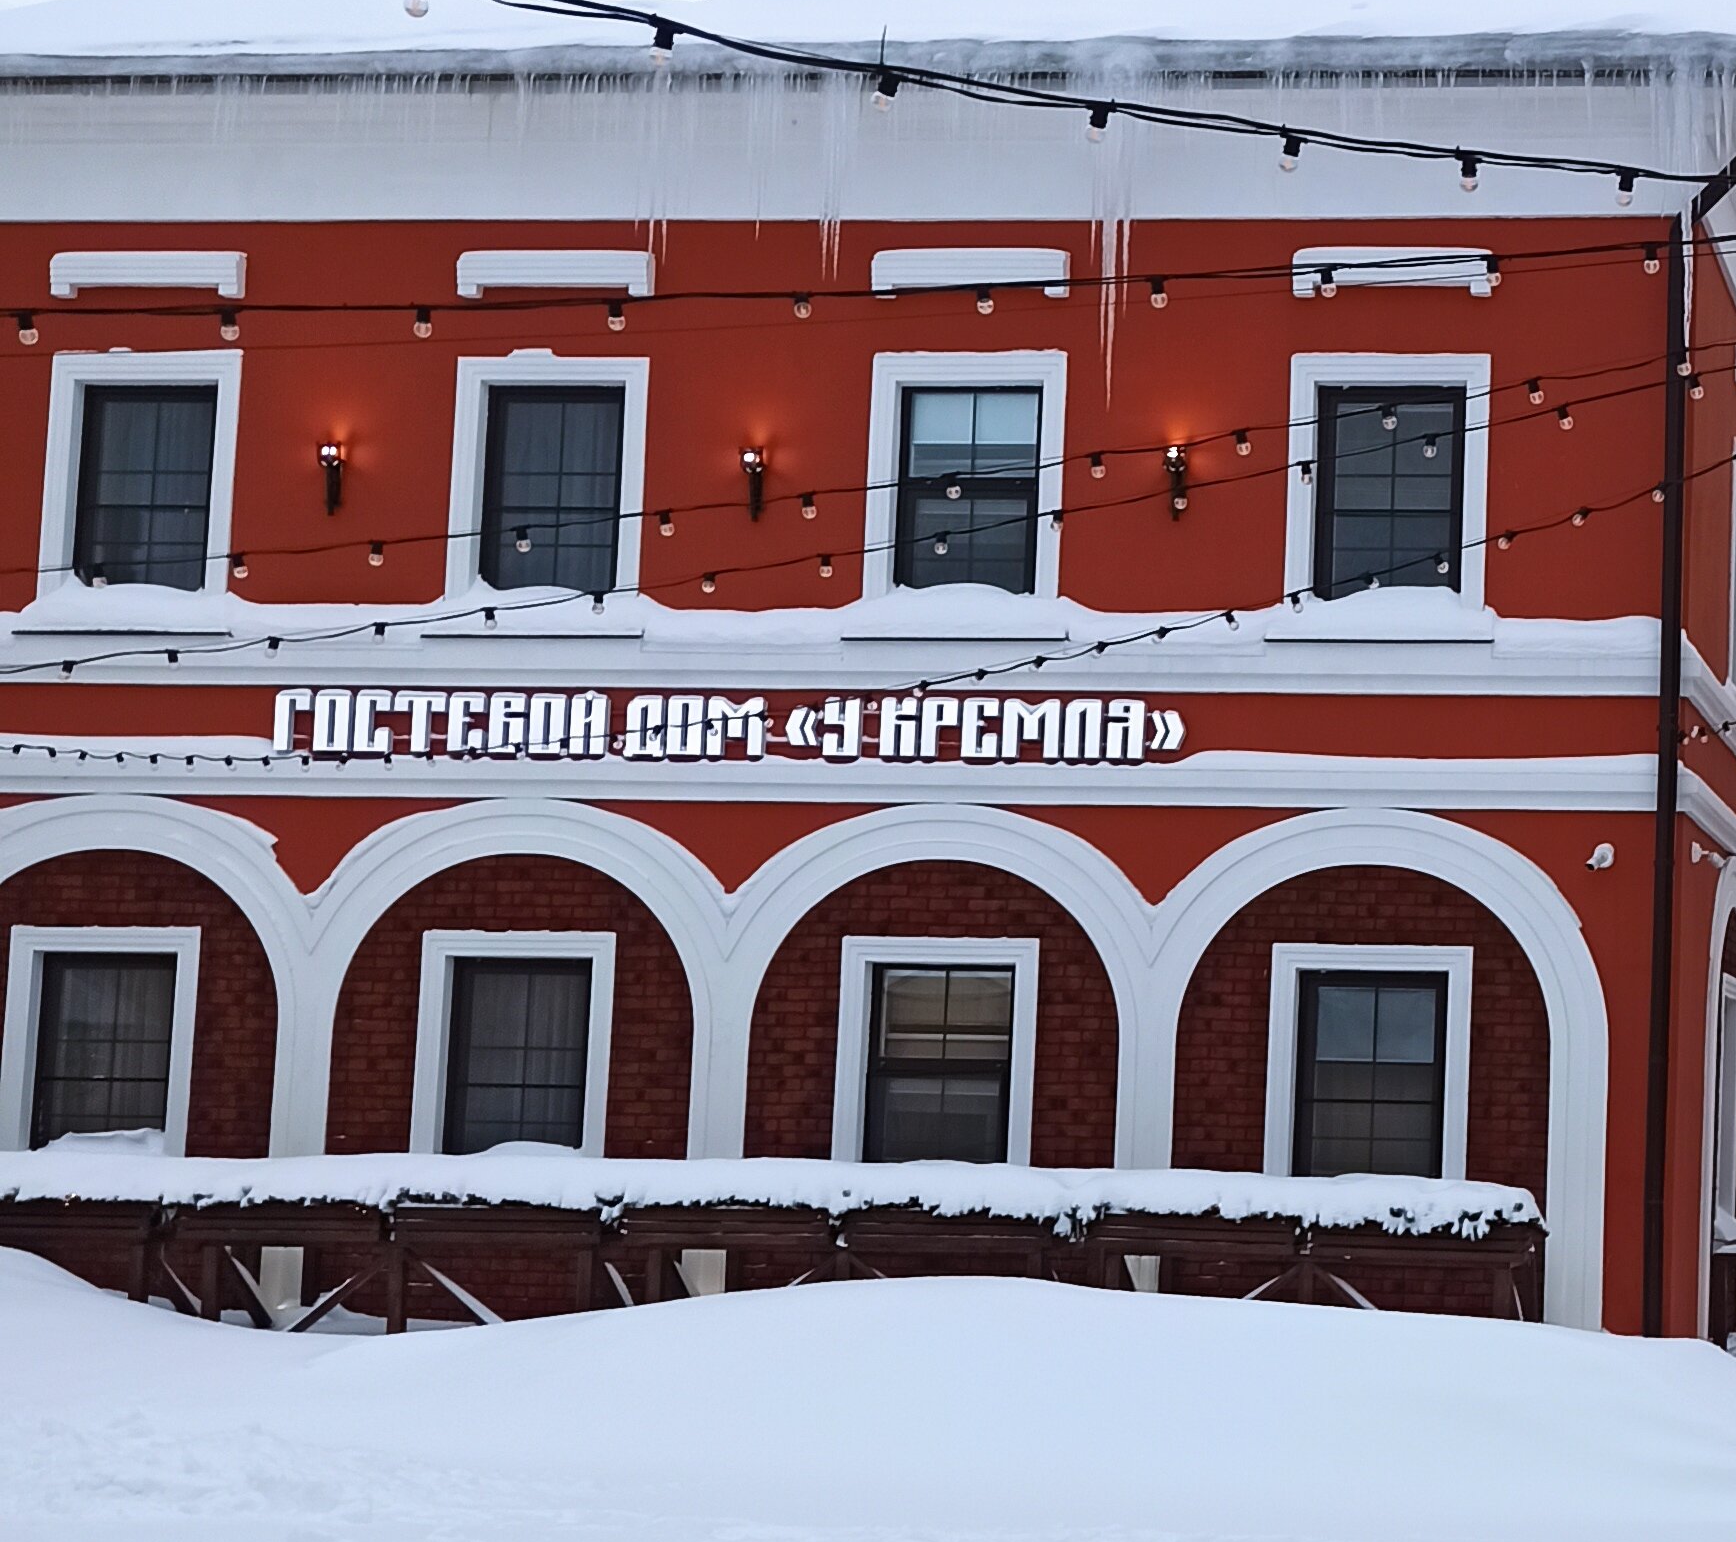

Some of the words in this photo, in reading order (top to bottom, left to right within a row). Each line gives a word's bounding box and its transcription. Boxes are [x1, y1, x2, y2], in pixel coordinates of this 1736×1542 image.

[273, 689, 611, 758] ГОСТЕВОЙ
[622, 694, 768, 760] ДОМ
[784, 695, 862, 760] «У
[878, 696, 1187, 761] КРЕМЛЯ»
